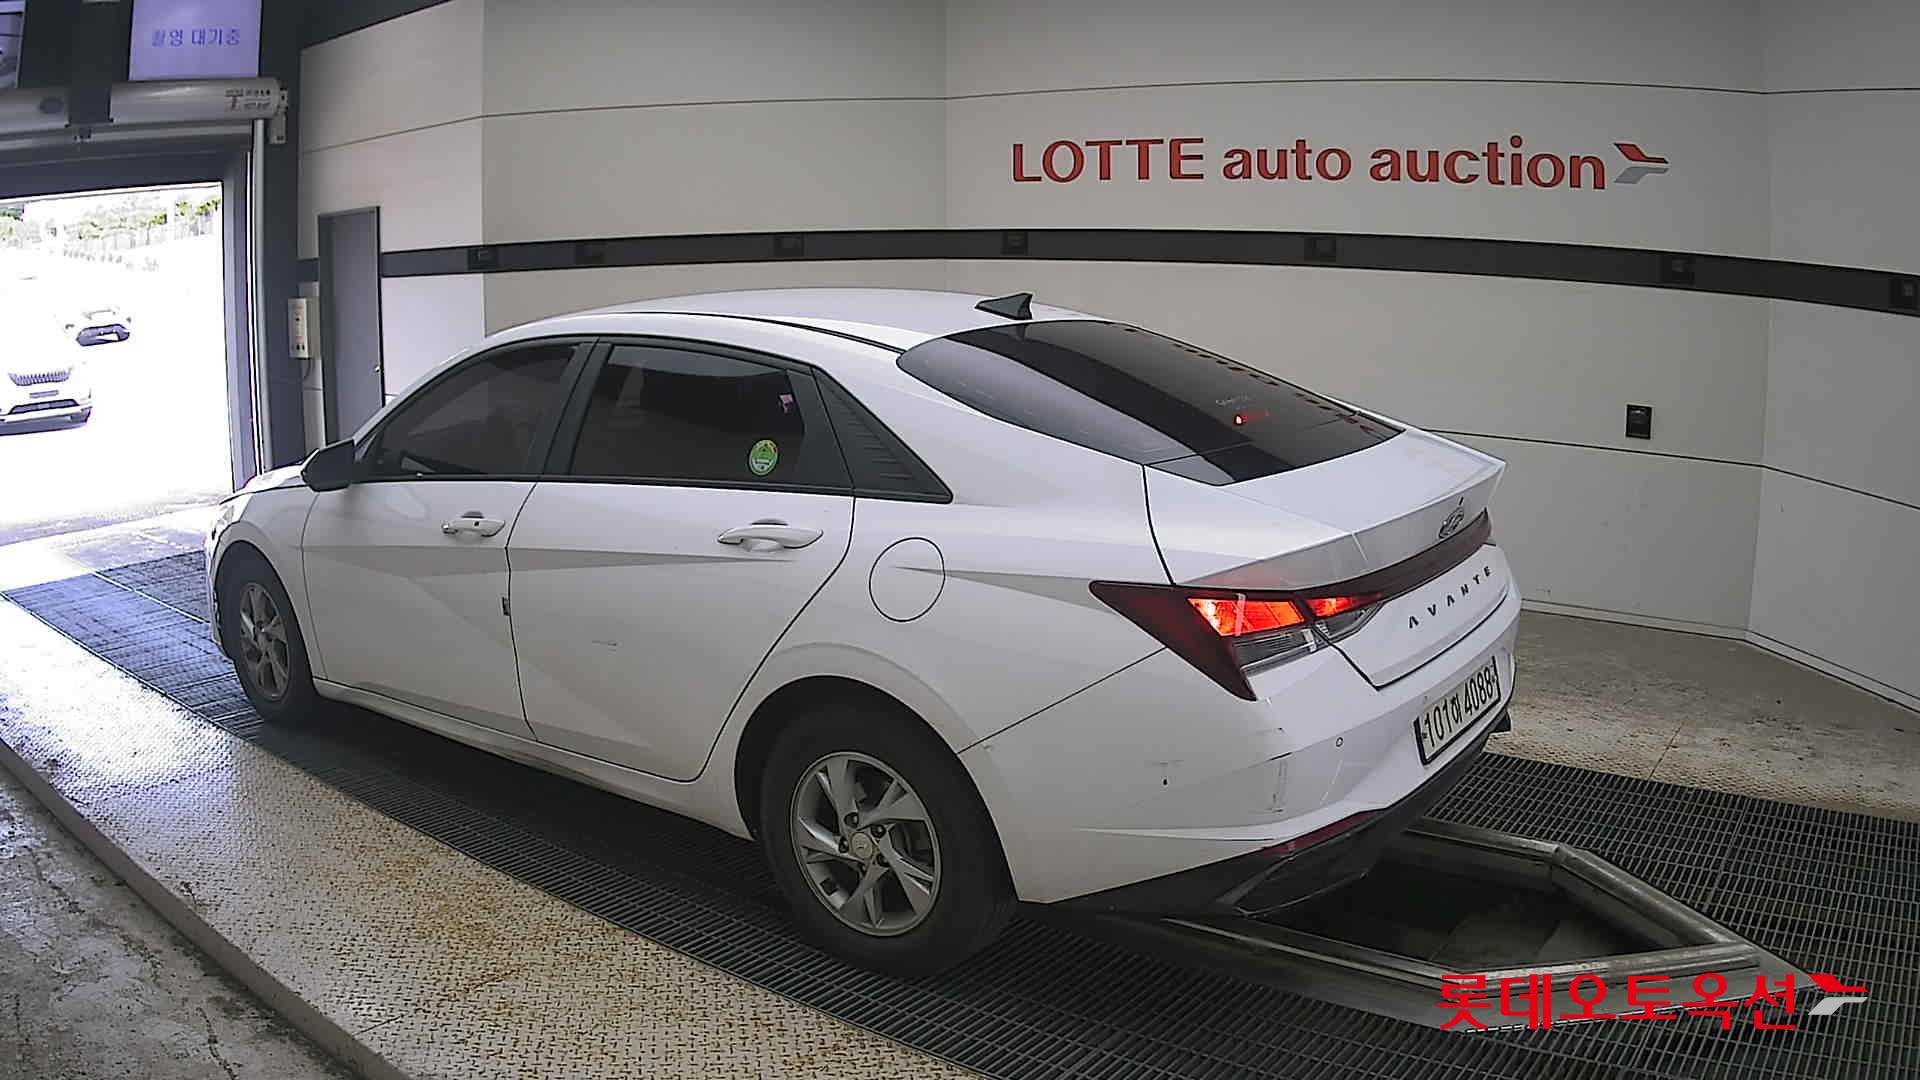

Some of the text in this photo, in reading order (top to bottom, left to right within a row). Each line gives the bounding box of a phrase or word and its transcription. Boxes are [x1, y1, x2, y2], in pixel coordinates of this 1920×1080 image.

[191, 28, 241, 46] 대기중
[1012, 135, 1606, 190] LOTTE auto auction
[1408, 565, 1491, 629] AVANTE
[1464, 666, 1494, 716] 4088
